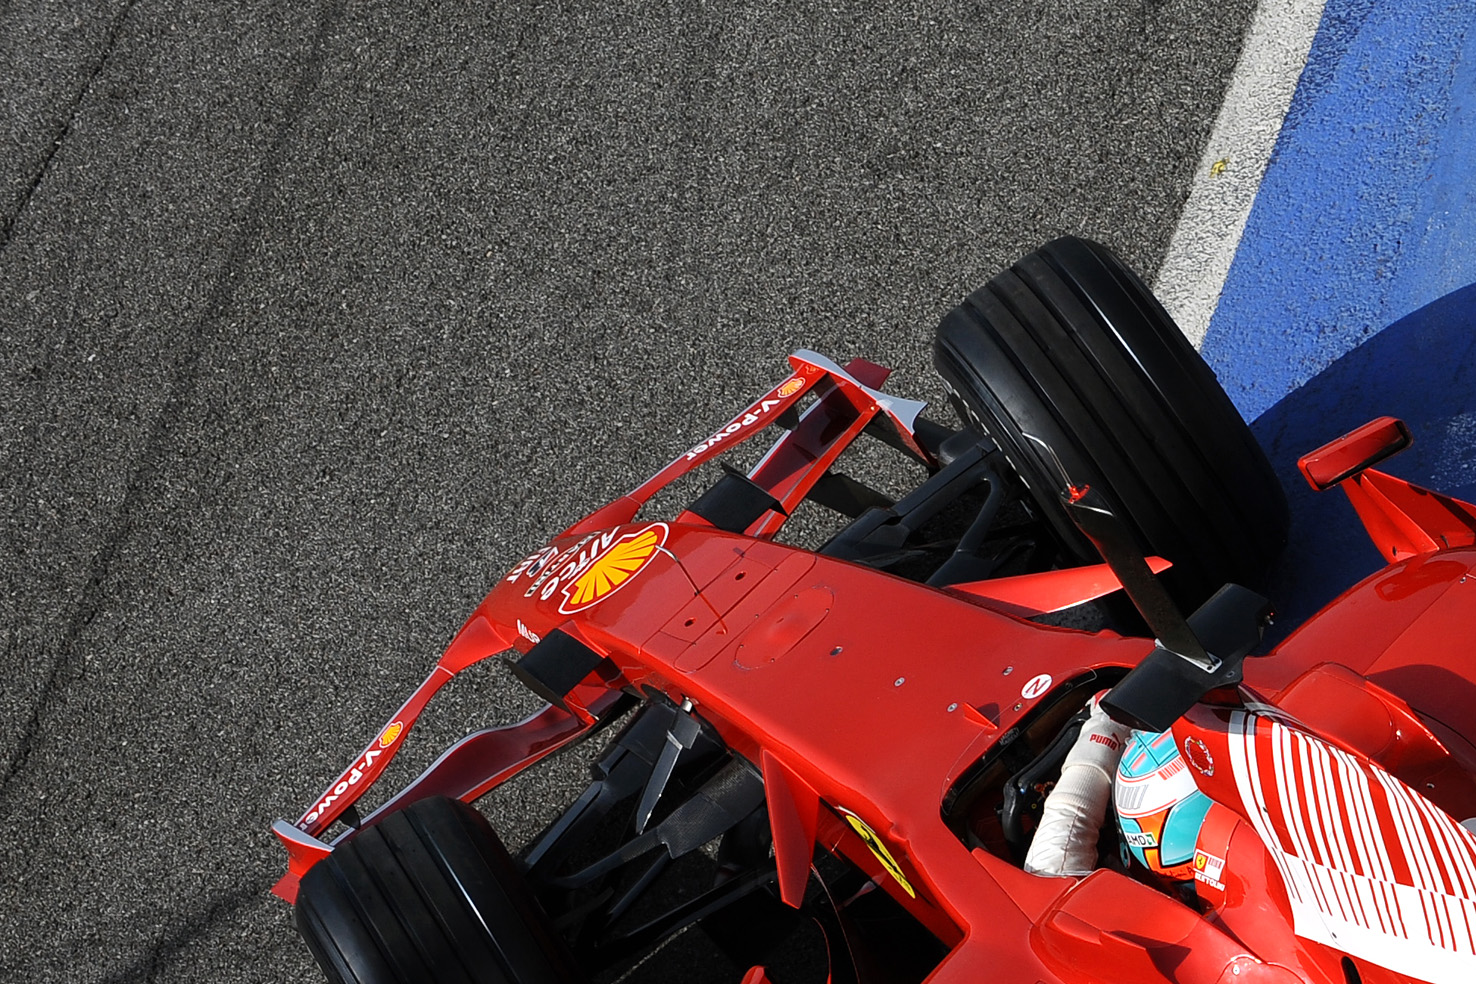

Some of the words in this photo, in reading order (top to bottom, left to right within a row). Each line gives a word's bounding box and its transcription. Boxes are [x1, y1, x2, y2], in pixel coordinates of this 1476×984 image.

[686, 400, 780, 460] V-Power
[506, 547, 552, 584] FIAT
[1089, 733, 1117, 751] PUMA
[300, 750, 382, 830] V-Power
[1126, 835, 1146, 846] AMD
